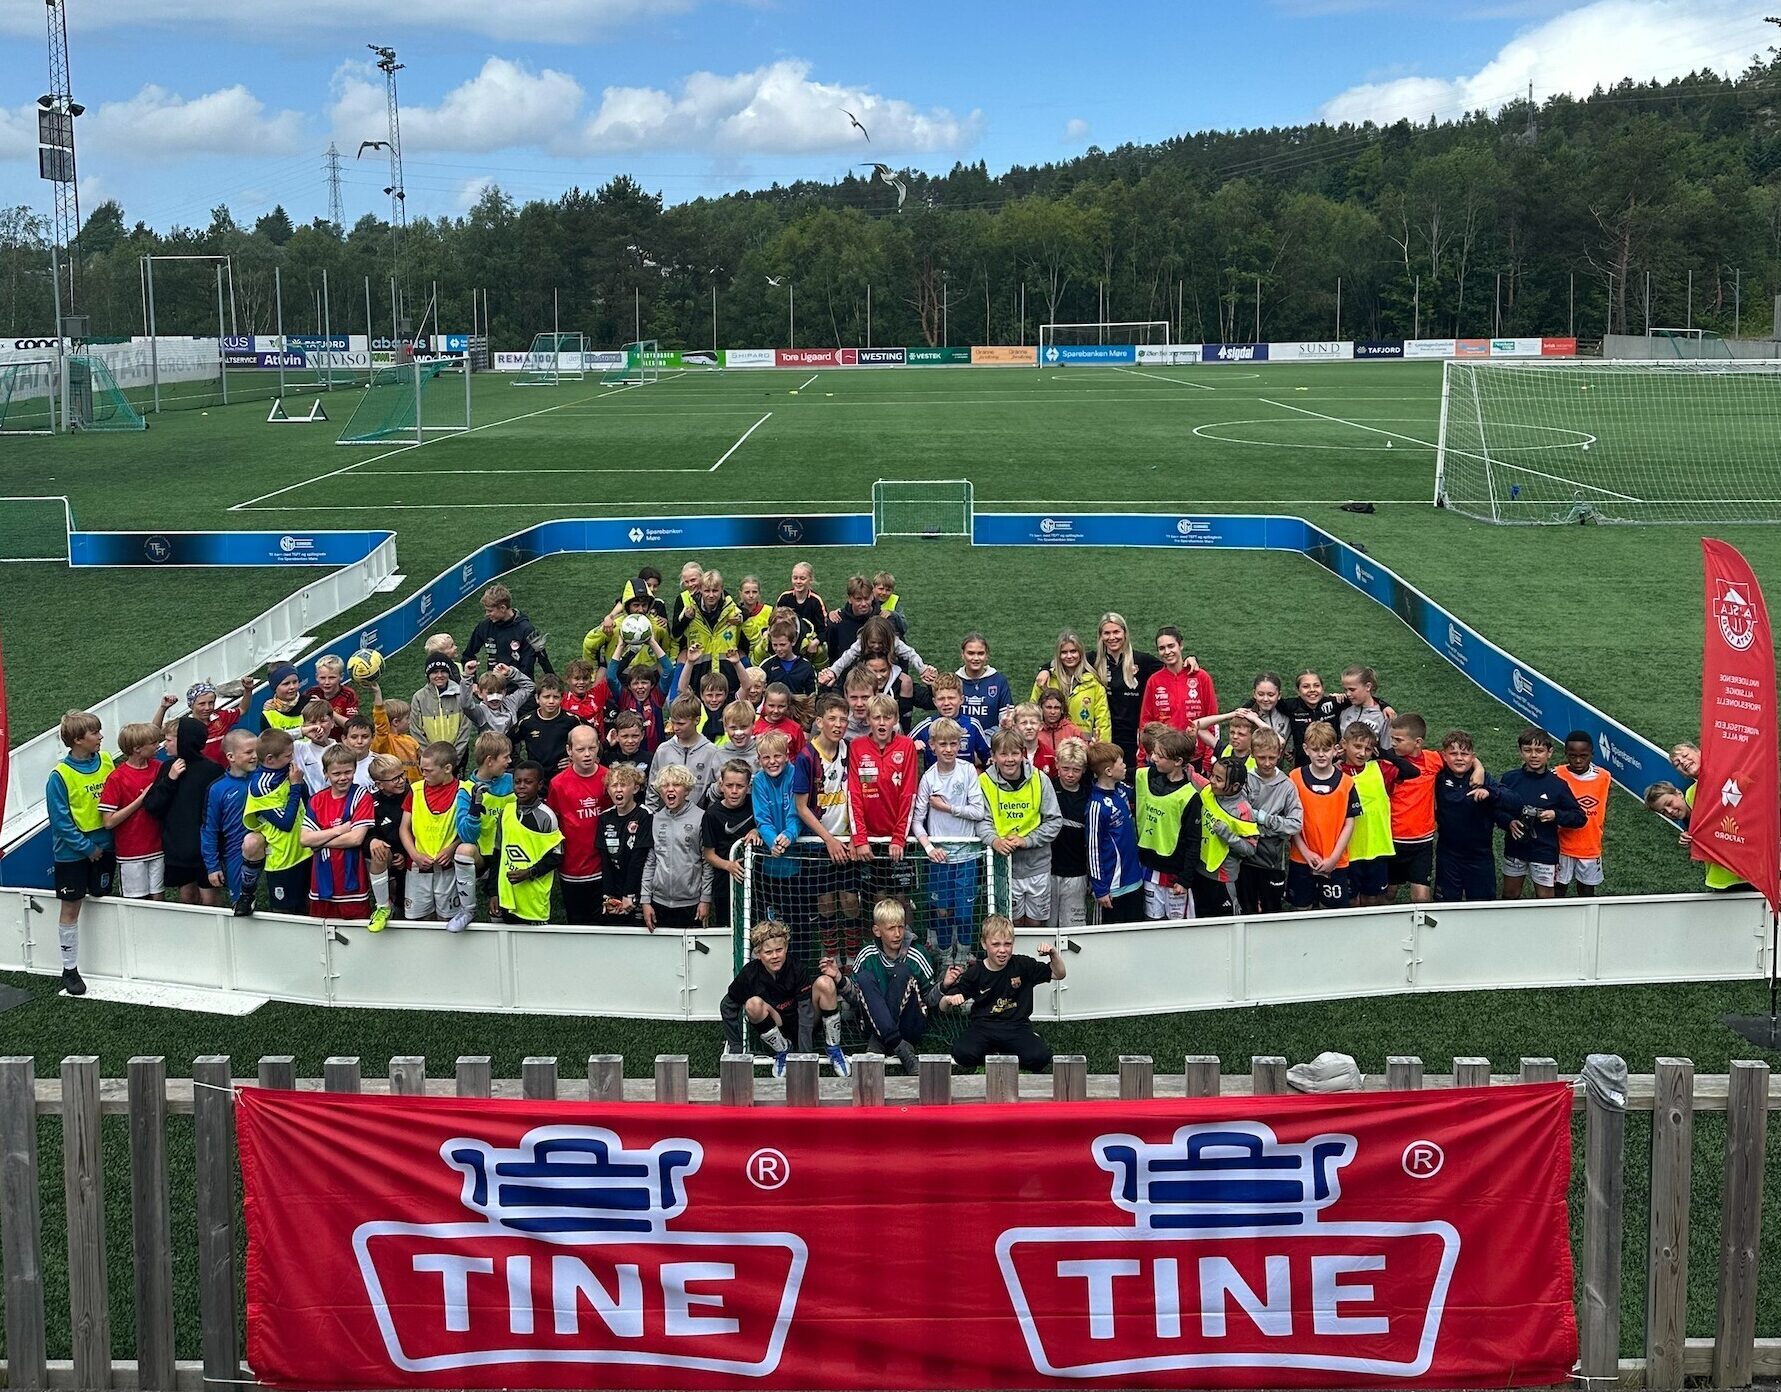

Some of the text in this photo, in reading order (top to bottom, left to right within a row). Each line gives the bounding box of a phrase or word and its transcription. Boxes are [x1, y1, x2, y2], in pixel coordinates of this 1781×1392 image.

[1299, 343, 1340, 352] SUND
[782, 353, 799, 361] Tore
[1062, 350, 1108, 358] Sparebanken
[1227, 346, 1254, 360] sigdal
[498, 355, 557, 363] REMA 100
[961, 705, 988, 715] TINE
[84, 782, 105, 792] Telen
[998, 802, 1029, 810] Telenor
[1146, 803, 1165, 816] lenor
[577, 807, 600, 819] TINE
[1005, 811, 1023, 819] Xtra
[1203, 808, 1220, 824] Tele
[1146, 815, 1157, 823] tra
[412, 1253, 740, 1338] TINE
[1056, 1254, 1390, 1339] TINE
